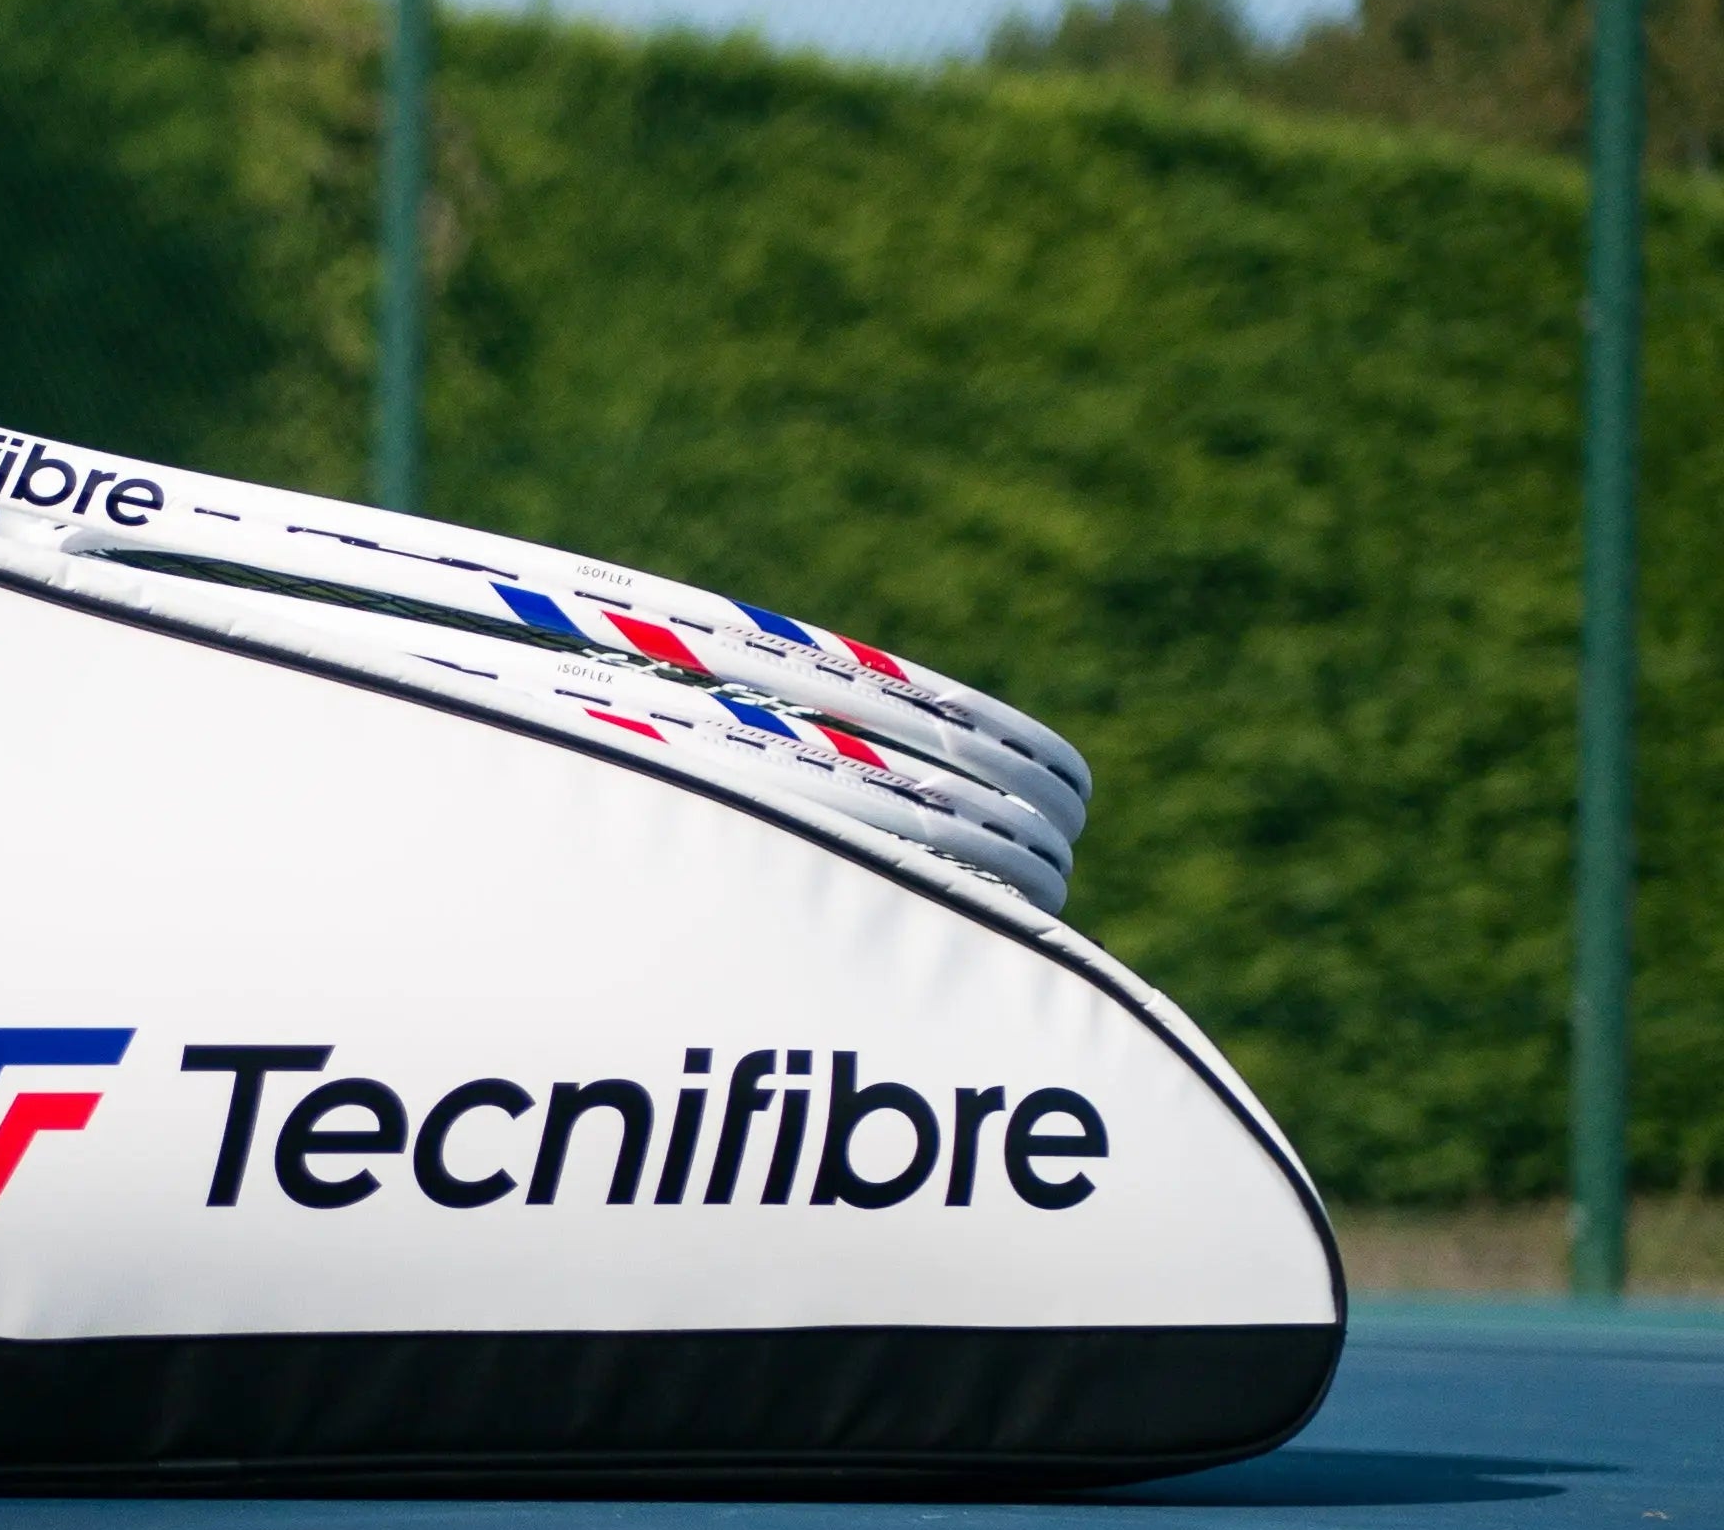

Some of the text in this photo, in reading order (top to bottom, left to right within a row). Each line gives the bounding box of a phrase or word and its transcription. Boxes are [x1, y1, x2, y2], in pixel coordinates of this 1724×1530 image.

[576, 565, 633, 587] ISOFLEX
[557, 663, 614, 684] ISOFLEX
[180, 1044, 1109, 1211] Tecnifibre
